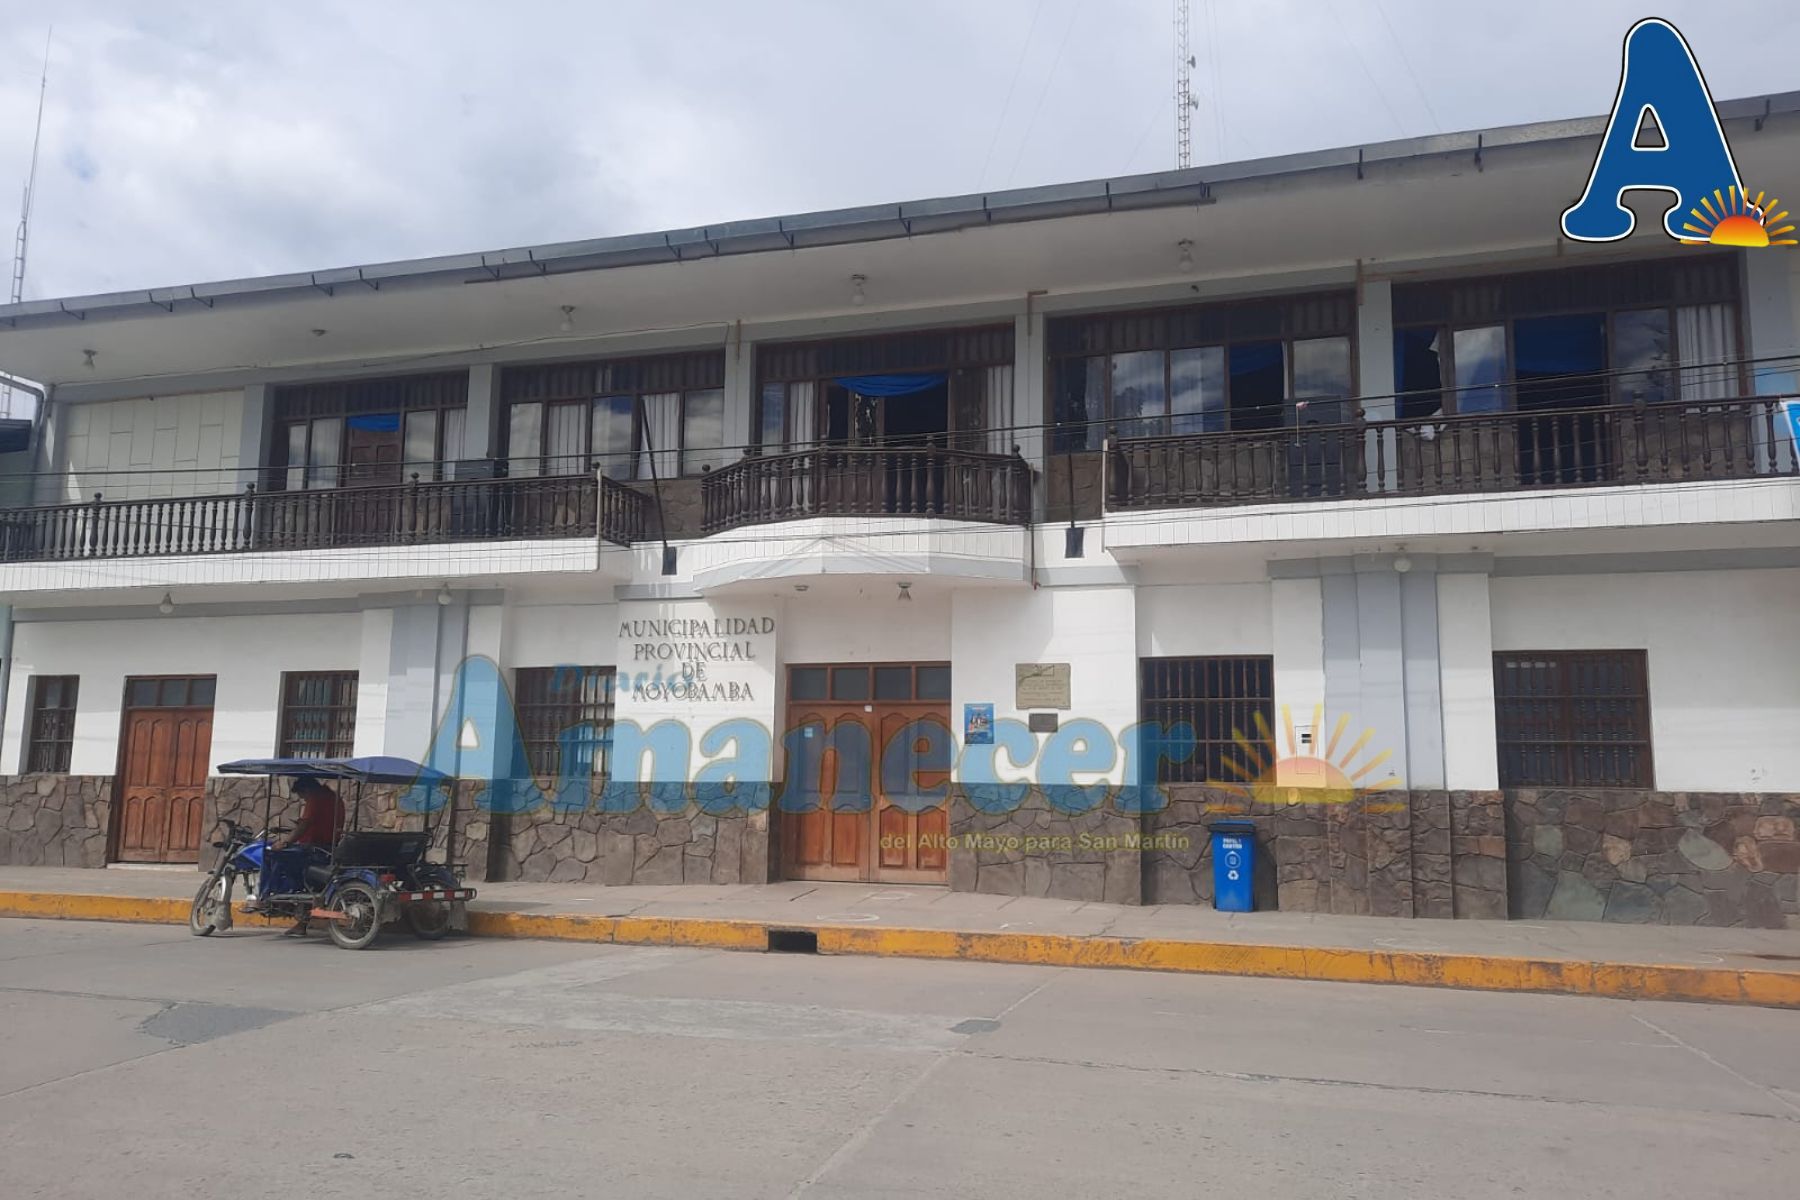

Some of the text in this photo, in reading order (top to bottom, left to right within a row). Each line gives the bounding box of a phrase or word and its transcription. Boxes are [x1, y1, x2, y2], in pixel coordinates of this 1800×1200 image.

[619, 616, 775, 638] MUNICIPALIDAD
[633, 641, 756, 662] PROVINCIAL
[682, 662, 707, 682] DE
[632, 681, 755, 702] MOYOBAMBA
